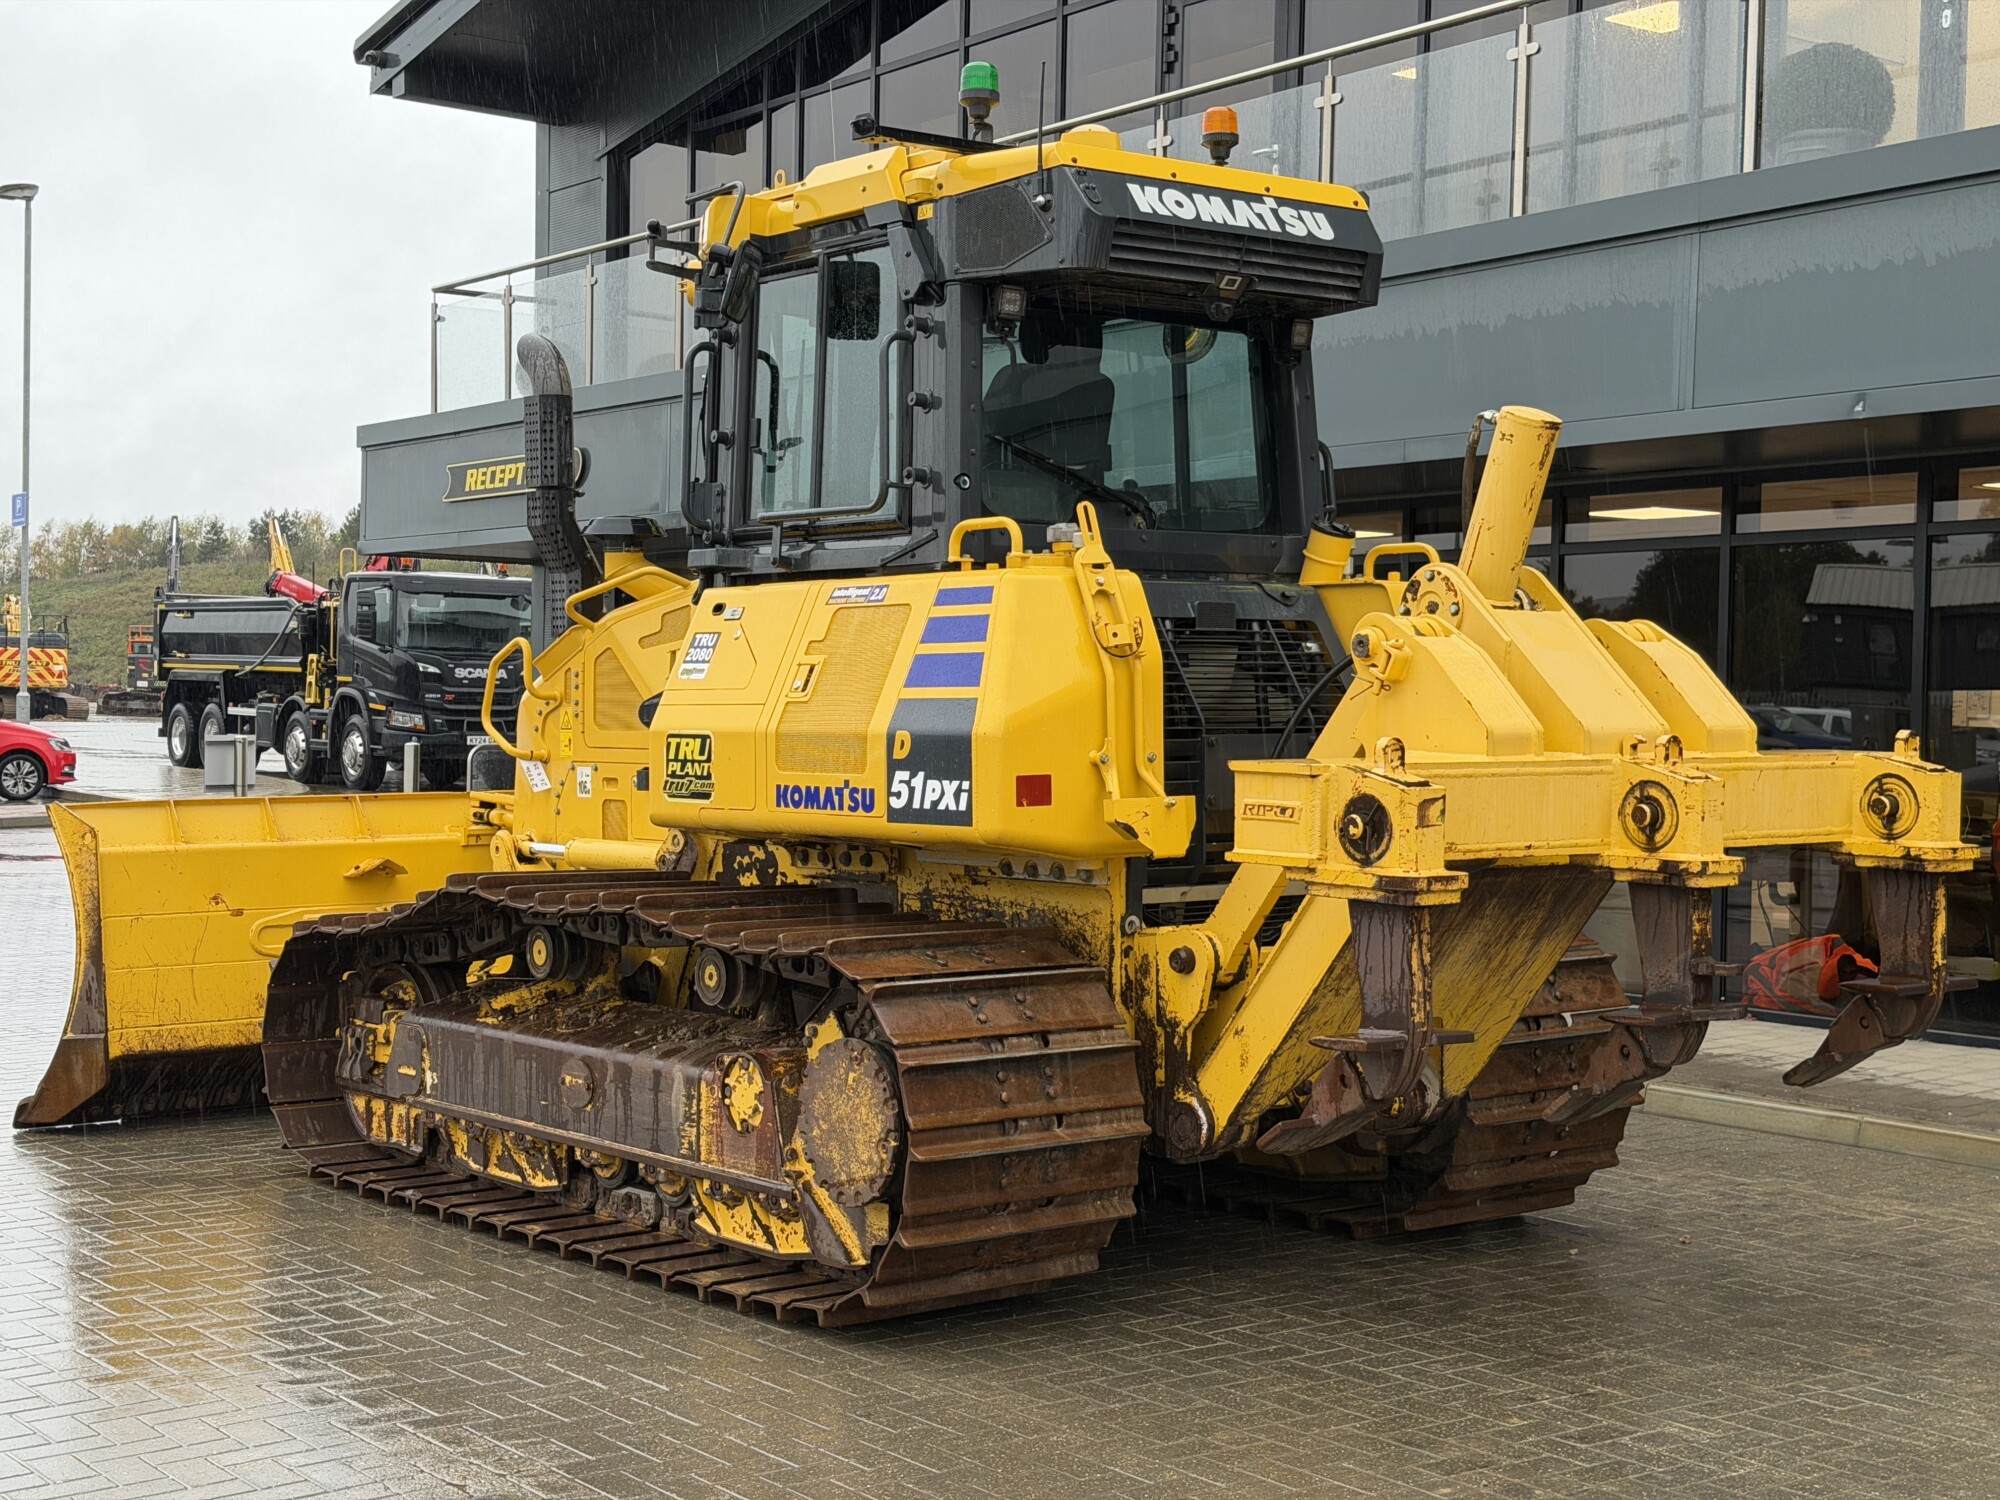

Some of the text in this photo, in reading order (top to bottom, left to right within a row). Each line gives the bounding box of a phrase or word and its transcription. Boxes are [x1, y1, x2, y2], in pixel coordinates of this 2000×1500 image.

[1126, 183, 1335, 241] KOMATSU
[464, 462, 526, 492] RECEPT
[869, 587, 888, 600] 2.0
[693, 633, 719, 647] TRU
[684, 647, 714, 662] 2080
[667, 738, 711, 760] TRU
[892, 730, 912, 760] D
[667, 761, 710, 776] PLANT
[663, 779, 715, 793] tru7.com
[775, 779, 875, 814] KOMATSU
[889, 770, 970, 812] 51PXi
